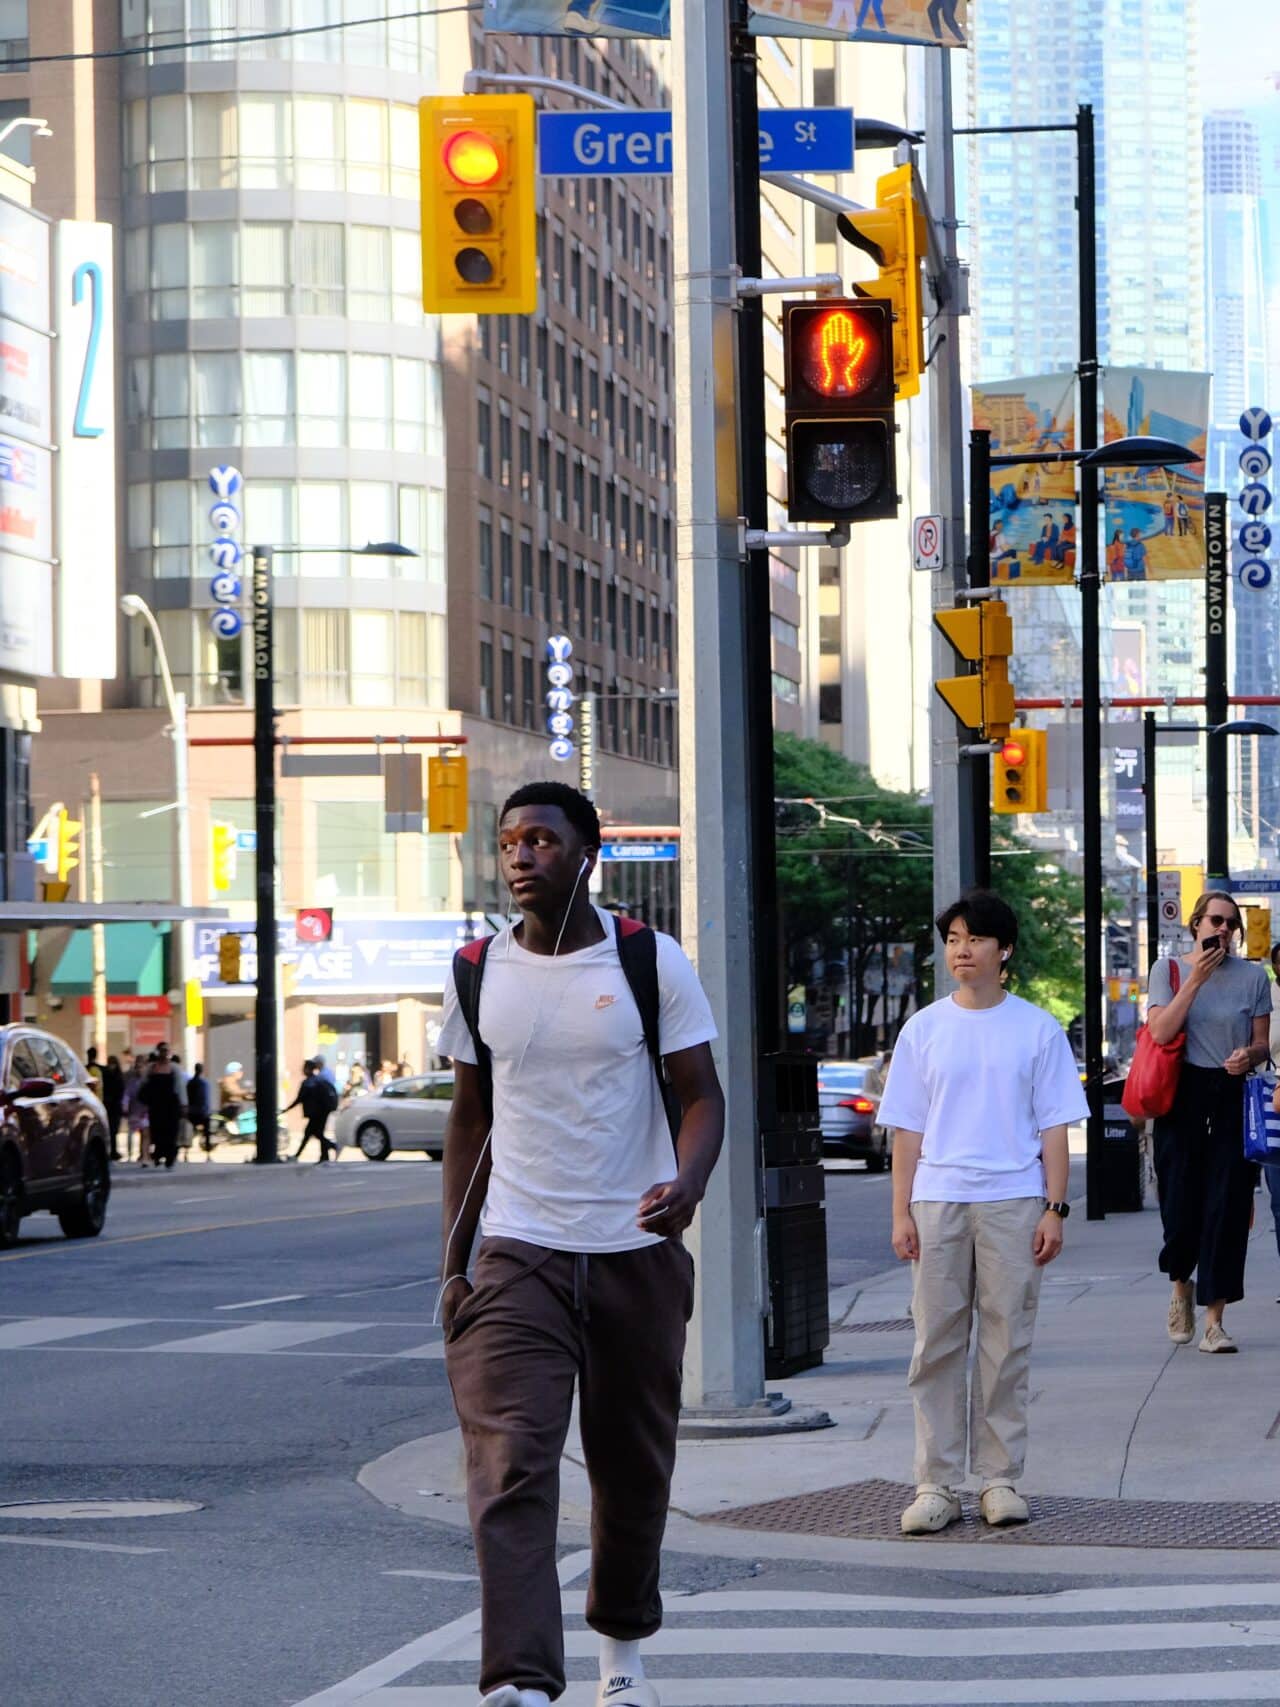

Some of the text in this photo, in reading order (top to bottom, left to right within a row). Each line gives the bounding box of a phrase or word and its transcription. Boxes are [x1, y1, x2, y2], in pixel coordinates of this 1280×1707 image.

[794, 120, 817, 144] St
[72, 261, 105, 437] 2
[255, 556, 269, 679] DOWNTOWN
[1209, 504, 1222, 634] DOWNTOWN
[608, 1676, 634, 1689] NIKE
